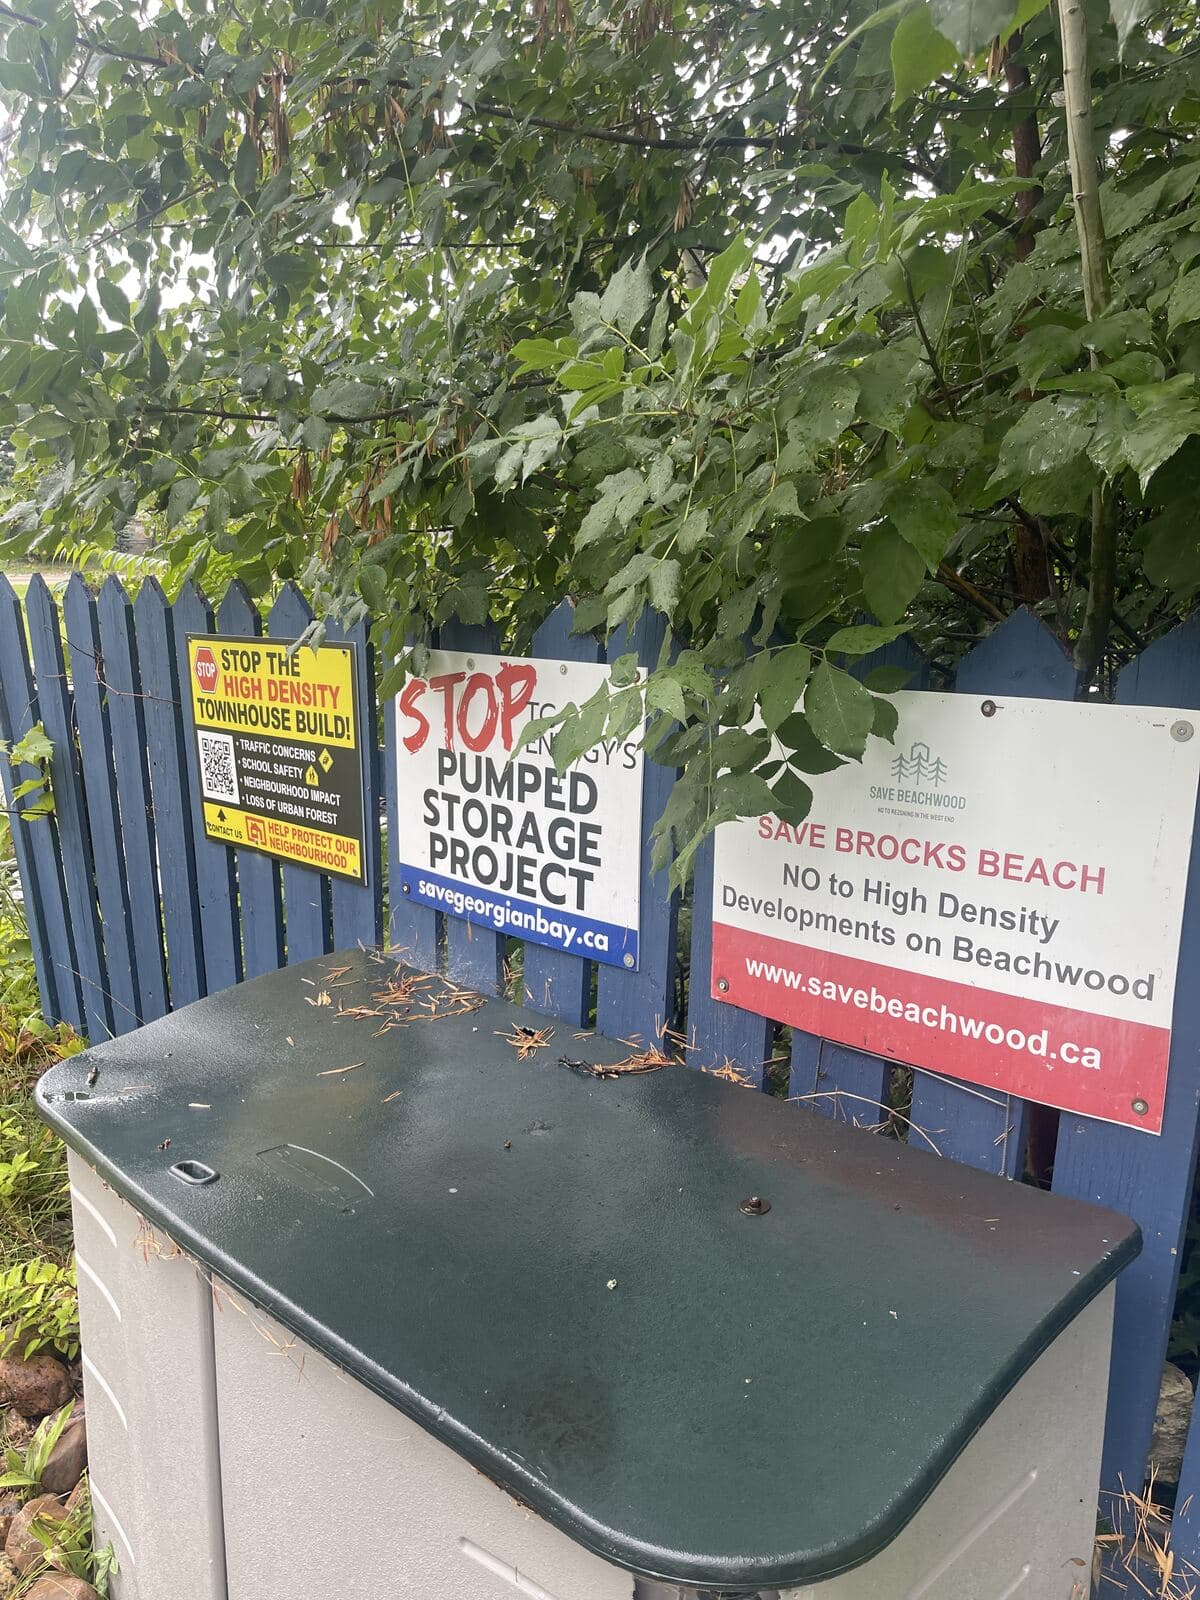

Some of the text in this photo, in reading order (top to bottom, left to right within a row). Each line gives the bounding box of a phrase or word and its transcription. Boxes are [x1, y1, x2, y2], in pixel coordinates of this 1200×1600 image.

[196, 662, 216, 678] STOP
[221, 649, 300, 677] STOP THE
[223, 675, 340, 709] HIGH DENSITY
[400, 662, 537, 755] STOP
[197, 697, 351, 740] TOWNHOUSE BUILD!
[240, 739, 316, 762] TRAFFIC CONCERNS
[242, 757, 303, 779] SCHOOL SAFETY
[244, 776, 341, 806] NEIGHBOURHOOD IMPACT
[437, 747, 598, 815] PUMPED
[870, 786, 966, 810] SAVE BEACHWOOD
[245, 794, 338, 825] LOSS OF URBAN FOREST
[208, 823, 243, 839] CONTACT US
[268, 821, 356, 856] HELP PROTECT OUR
[423, 788, 602, 867] STORAGE
[269, 837, 347, 868] NEIGHBOURHOOD
[758, 816, 1106, 895] SAVE BROCKS BEACH
[429, 833, 594, 911] PROJECT
[418, 878, 609, 951] savegeorgianbay.ca
[783, 863, 1060, 944] NO to High Density
[722, 885, 1155, 1002] Developments on Beachwood
[745, 956, 1102, 1070] www.savebeachwood.ca
